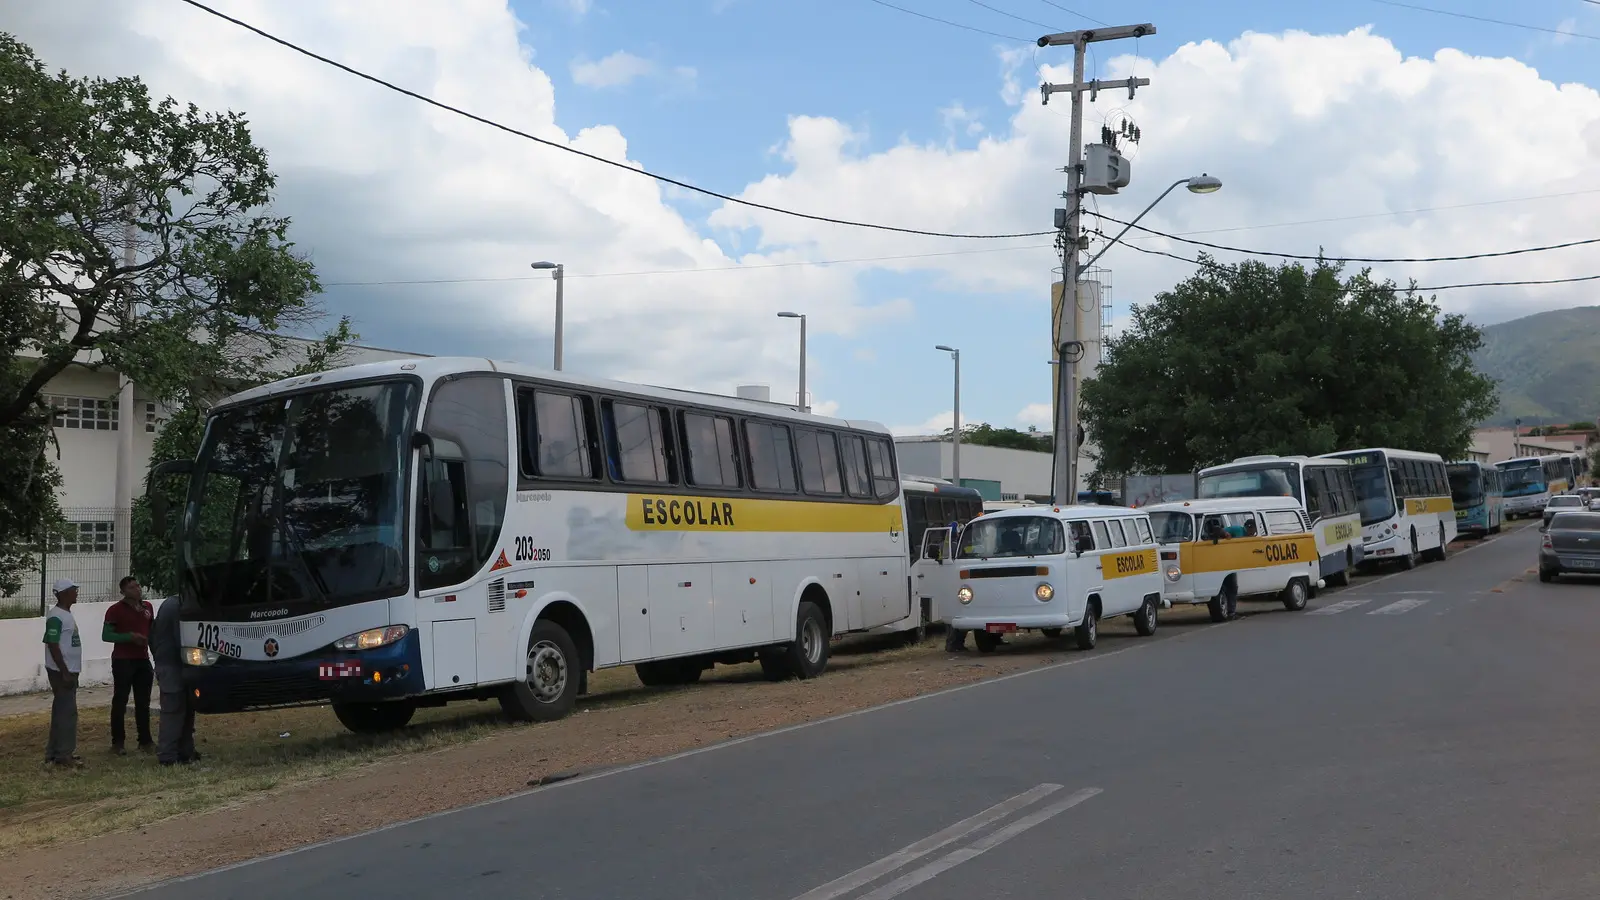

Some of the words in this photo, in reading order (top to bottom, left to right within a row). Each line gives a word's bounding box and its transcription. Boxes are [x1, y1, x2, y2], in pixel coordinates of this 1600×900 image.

[516, 493, 551, 503] Marcopolo
[642, 498, 734, 526] ESCOLAR
[515, 536, 533, 561] 203
[533, 549, 551, 561] 2050
[1265, 543, 1299, 562] COLAR
[1117, 554, 1145, 573] ESCOLAR
[250, 608, 289, 619] Marcopolo
[197, 622, 220, 652] 203
[219, 640, 242, 658] 2050
